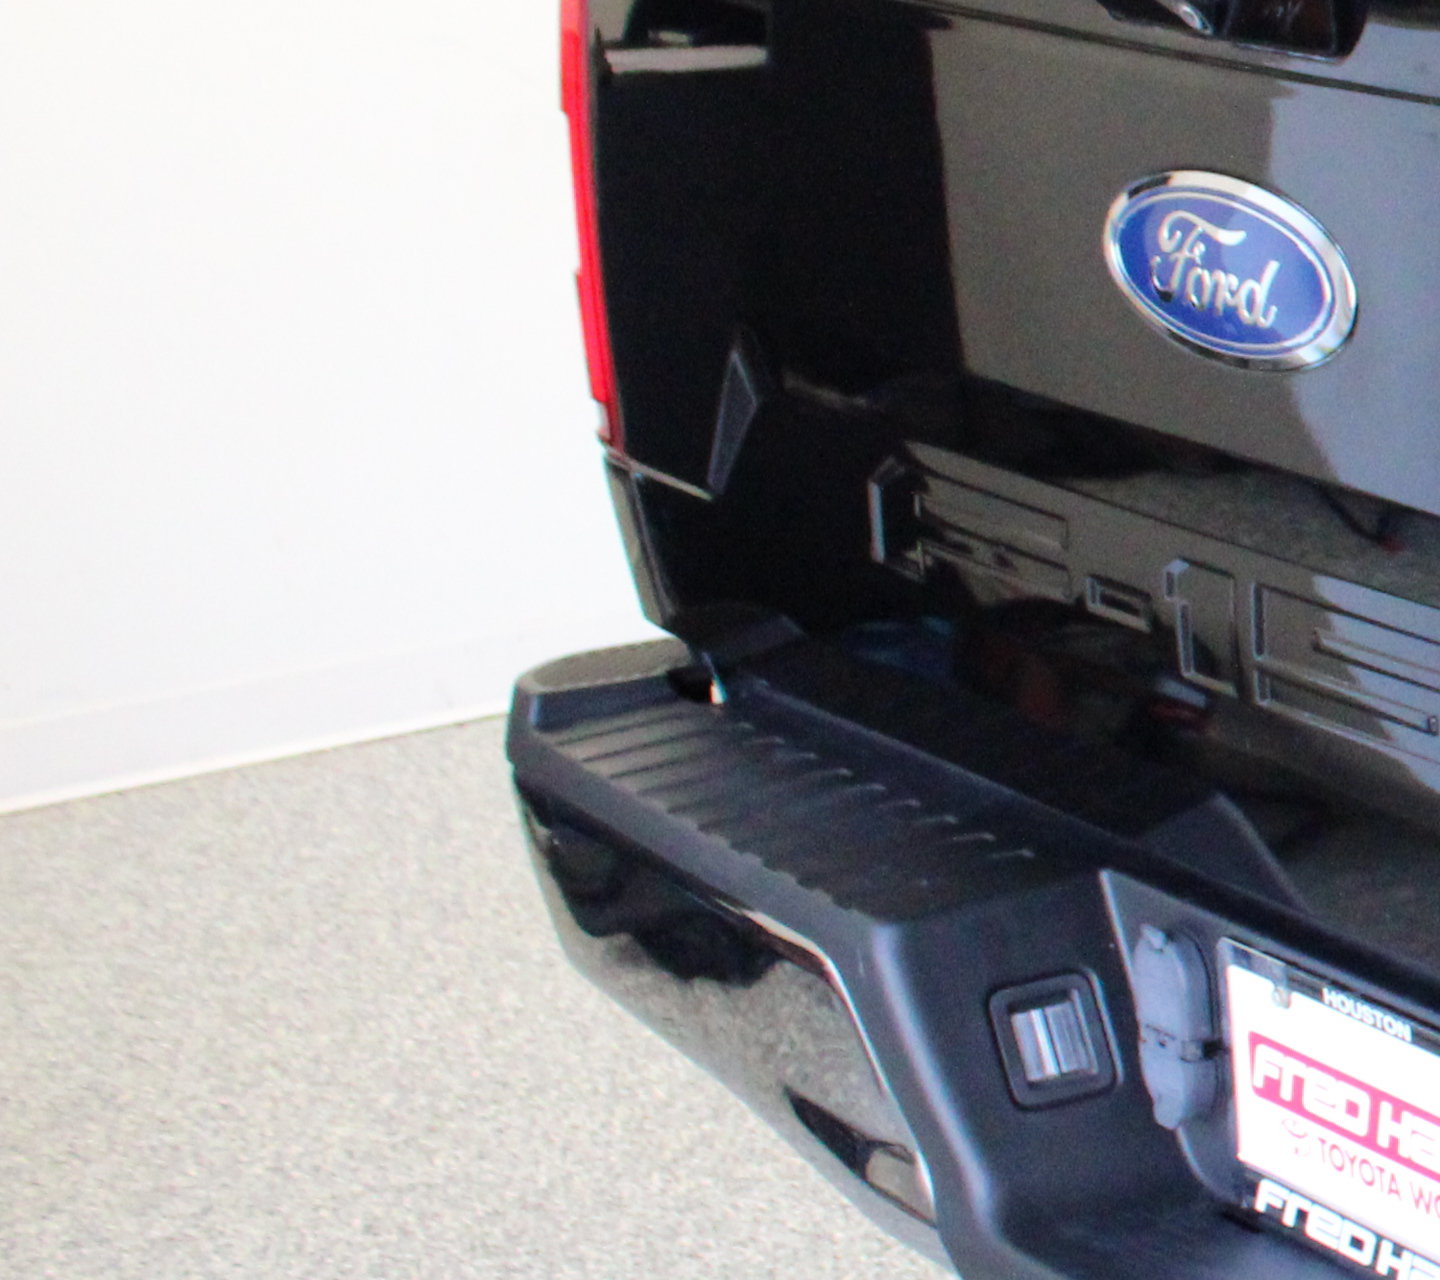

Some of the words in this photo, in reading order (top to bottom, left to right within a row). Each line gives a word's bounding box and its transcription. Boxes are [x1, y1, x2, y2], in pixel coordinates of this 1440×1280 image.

[1151, 210, 1280, 329] Ford
[1321, 987, 1413, 1043] HOUSTON
[1318, 1137, 1401, 1201] TOYOTA
